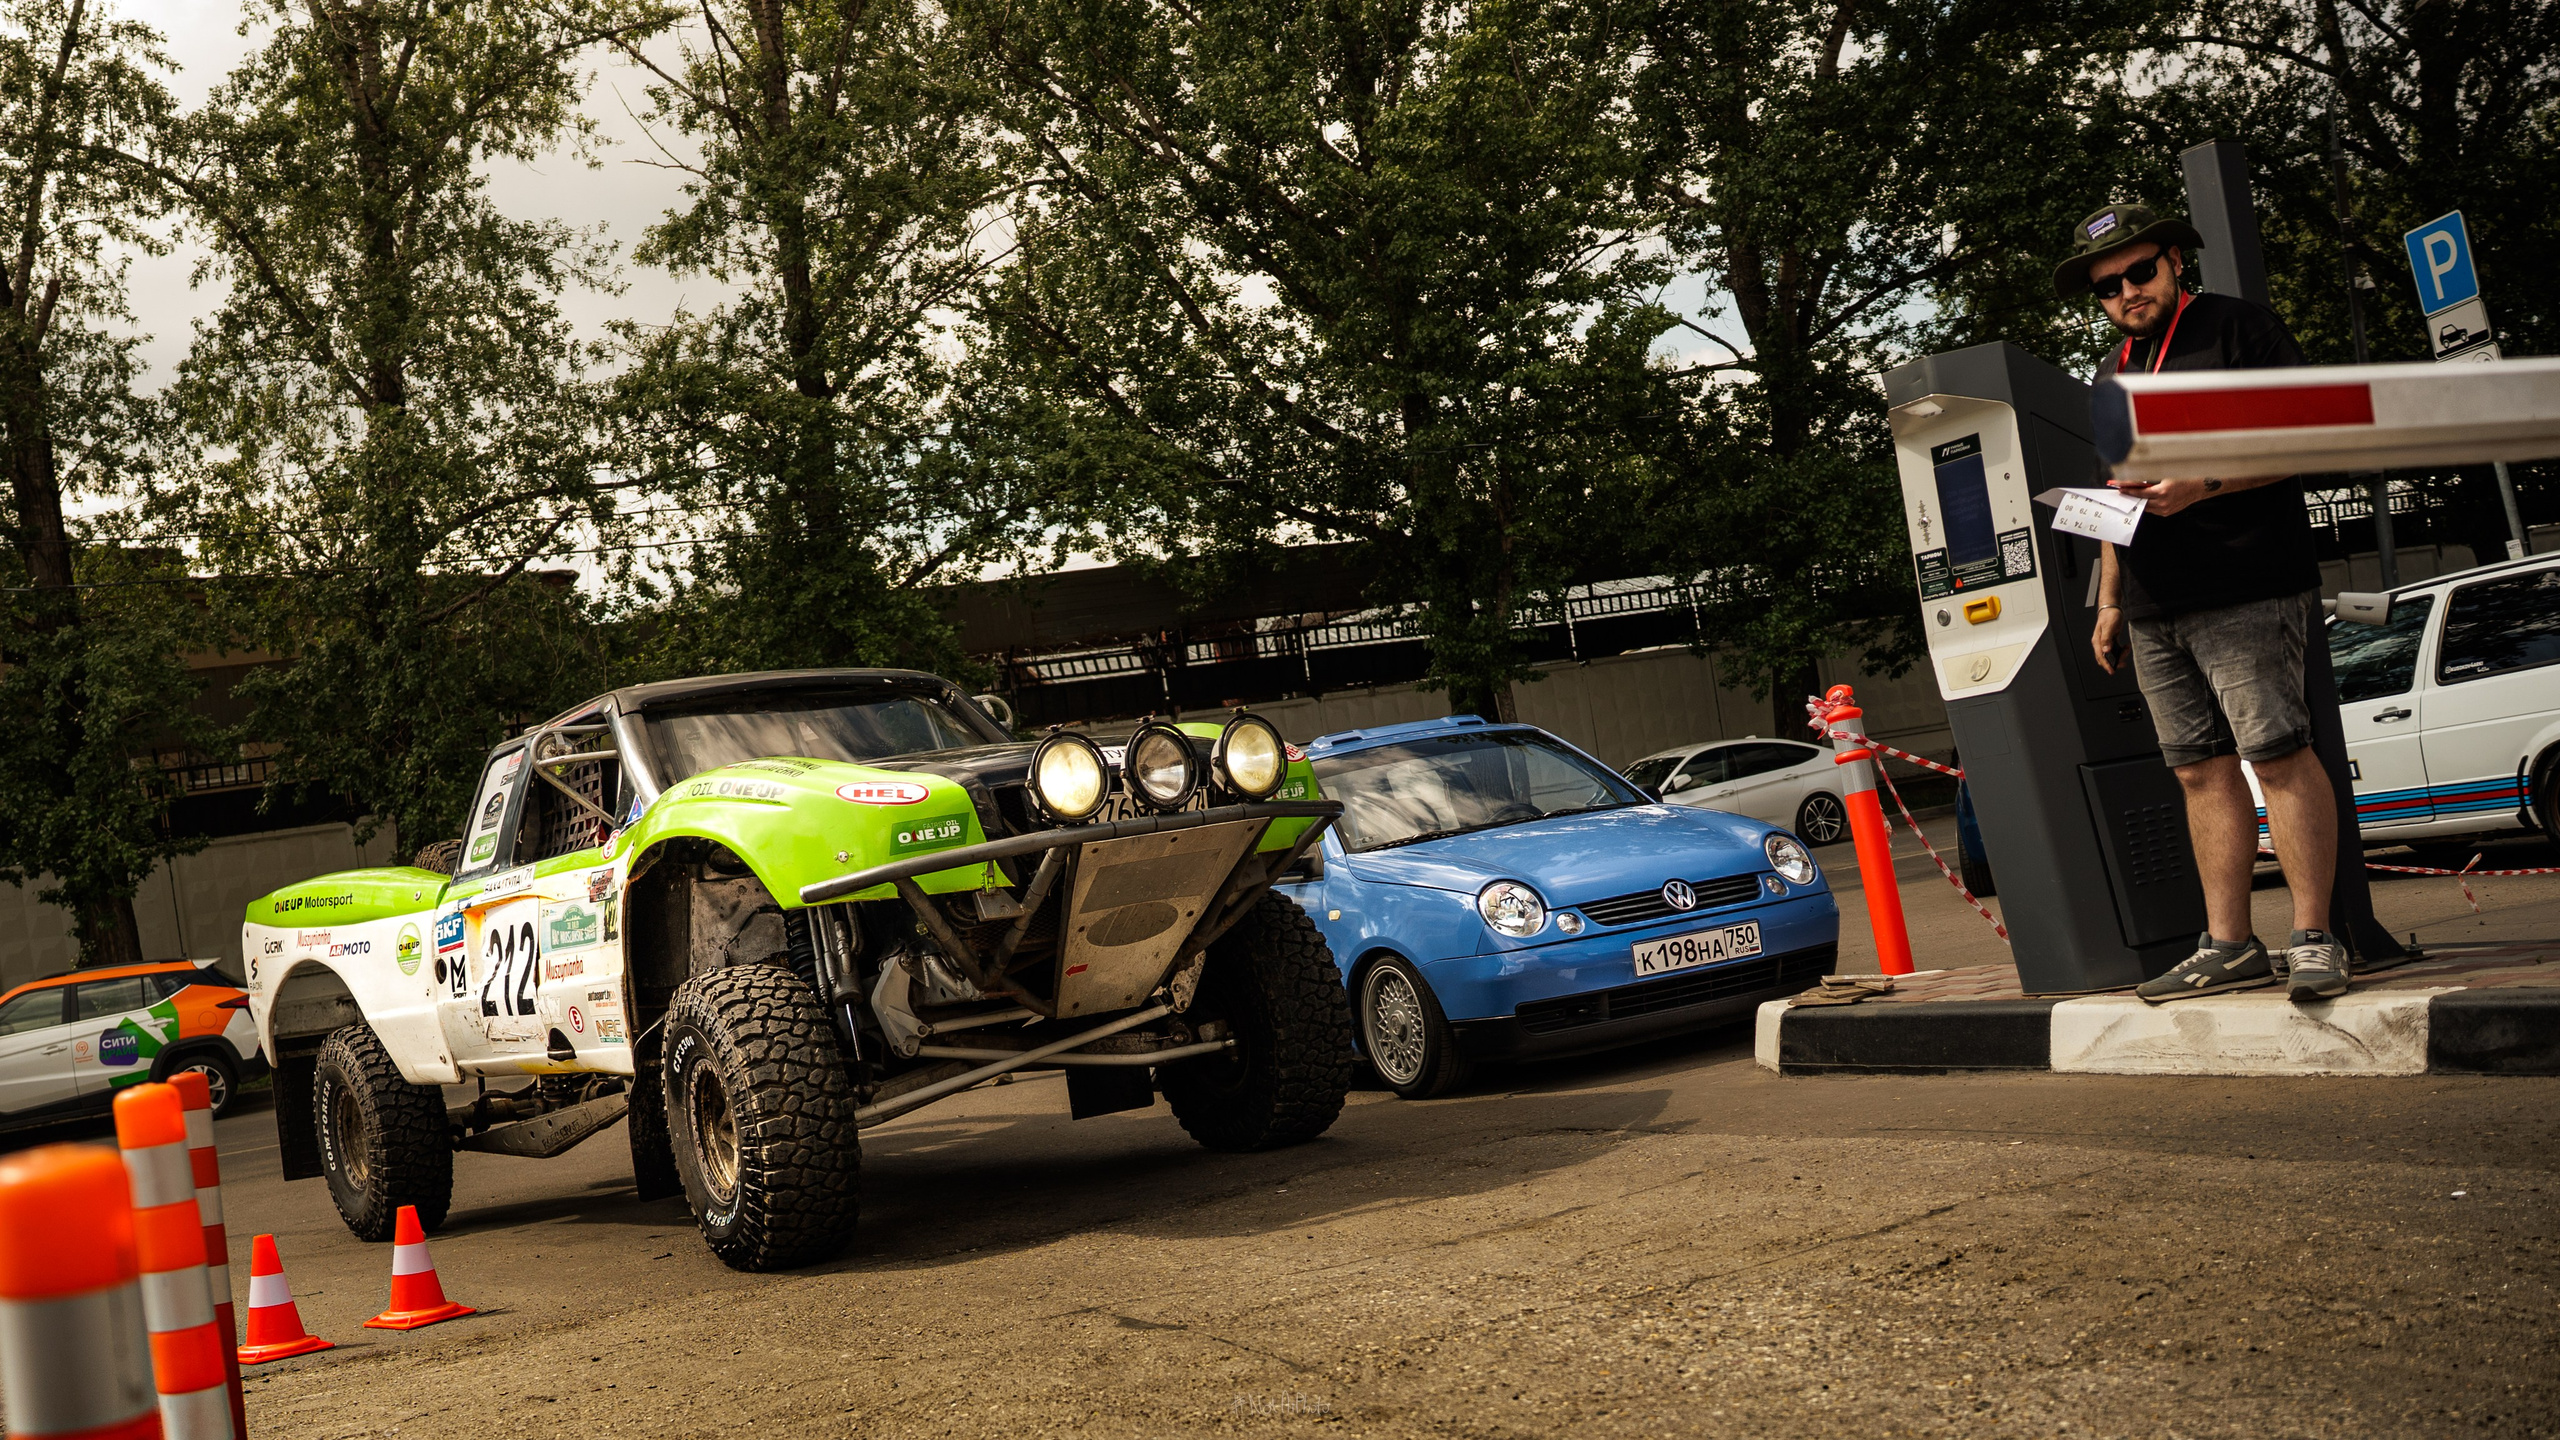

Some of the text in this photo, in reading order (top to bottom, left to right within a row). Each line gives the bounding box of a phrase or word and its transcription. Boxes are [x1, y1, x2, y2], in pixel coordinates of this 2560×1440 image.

[2422, 230, 2458, 300] P
[2064, 504, 2074, 512] 80
[2094, 510, 2103, 518] 78
[2059, 517, 2098, 532] 73 74 75
[2124, 517, 2132, 525] 76
[853, 788, 913, 800] HEL
[304, 893, 353, 909] Motorsport
[436, 918, 462, 941] SKF
[1725, 926, 1755, 949] 750
[1734, 946, 1750, 955] RUS
[481, 921, 536, 1018] 212
[101, 1036, 136, 1049] СИТИ
[673, 1035, 695, 1073] CF3300
[322, 1080, 336, 1171] COMFORSER
